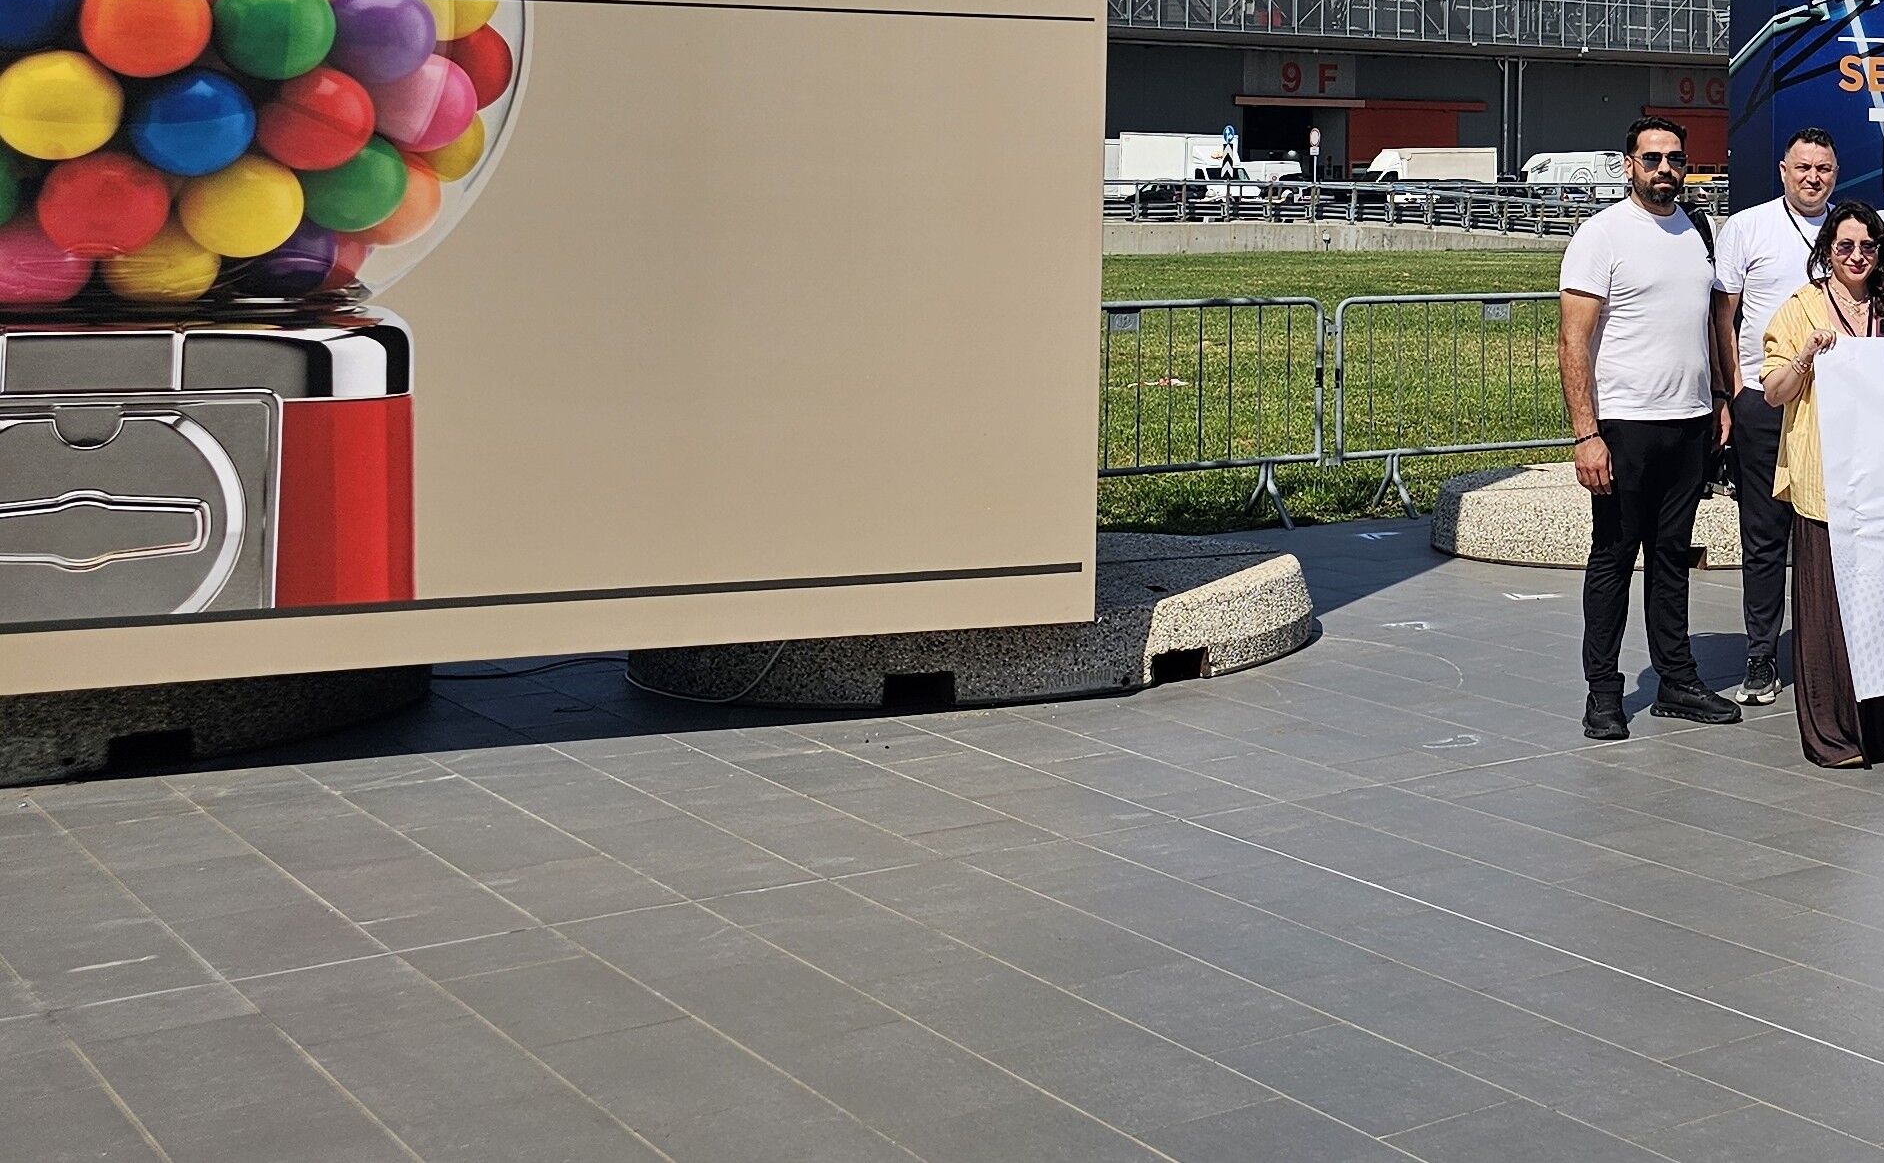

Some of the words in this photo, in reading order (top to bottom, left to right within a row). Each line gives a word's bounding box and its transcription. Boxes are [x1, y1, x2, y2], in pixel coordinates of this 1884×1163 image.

[1282, 62, 1302, 93] 9
[1319, 63, 1338, 94] F
[1679, 77, 1695, 104] 9
